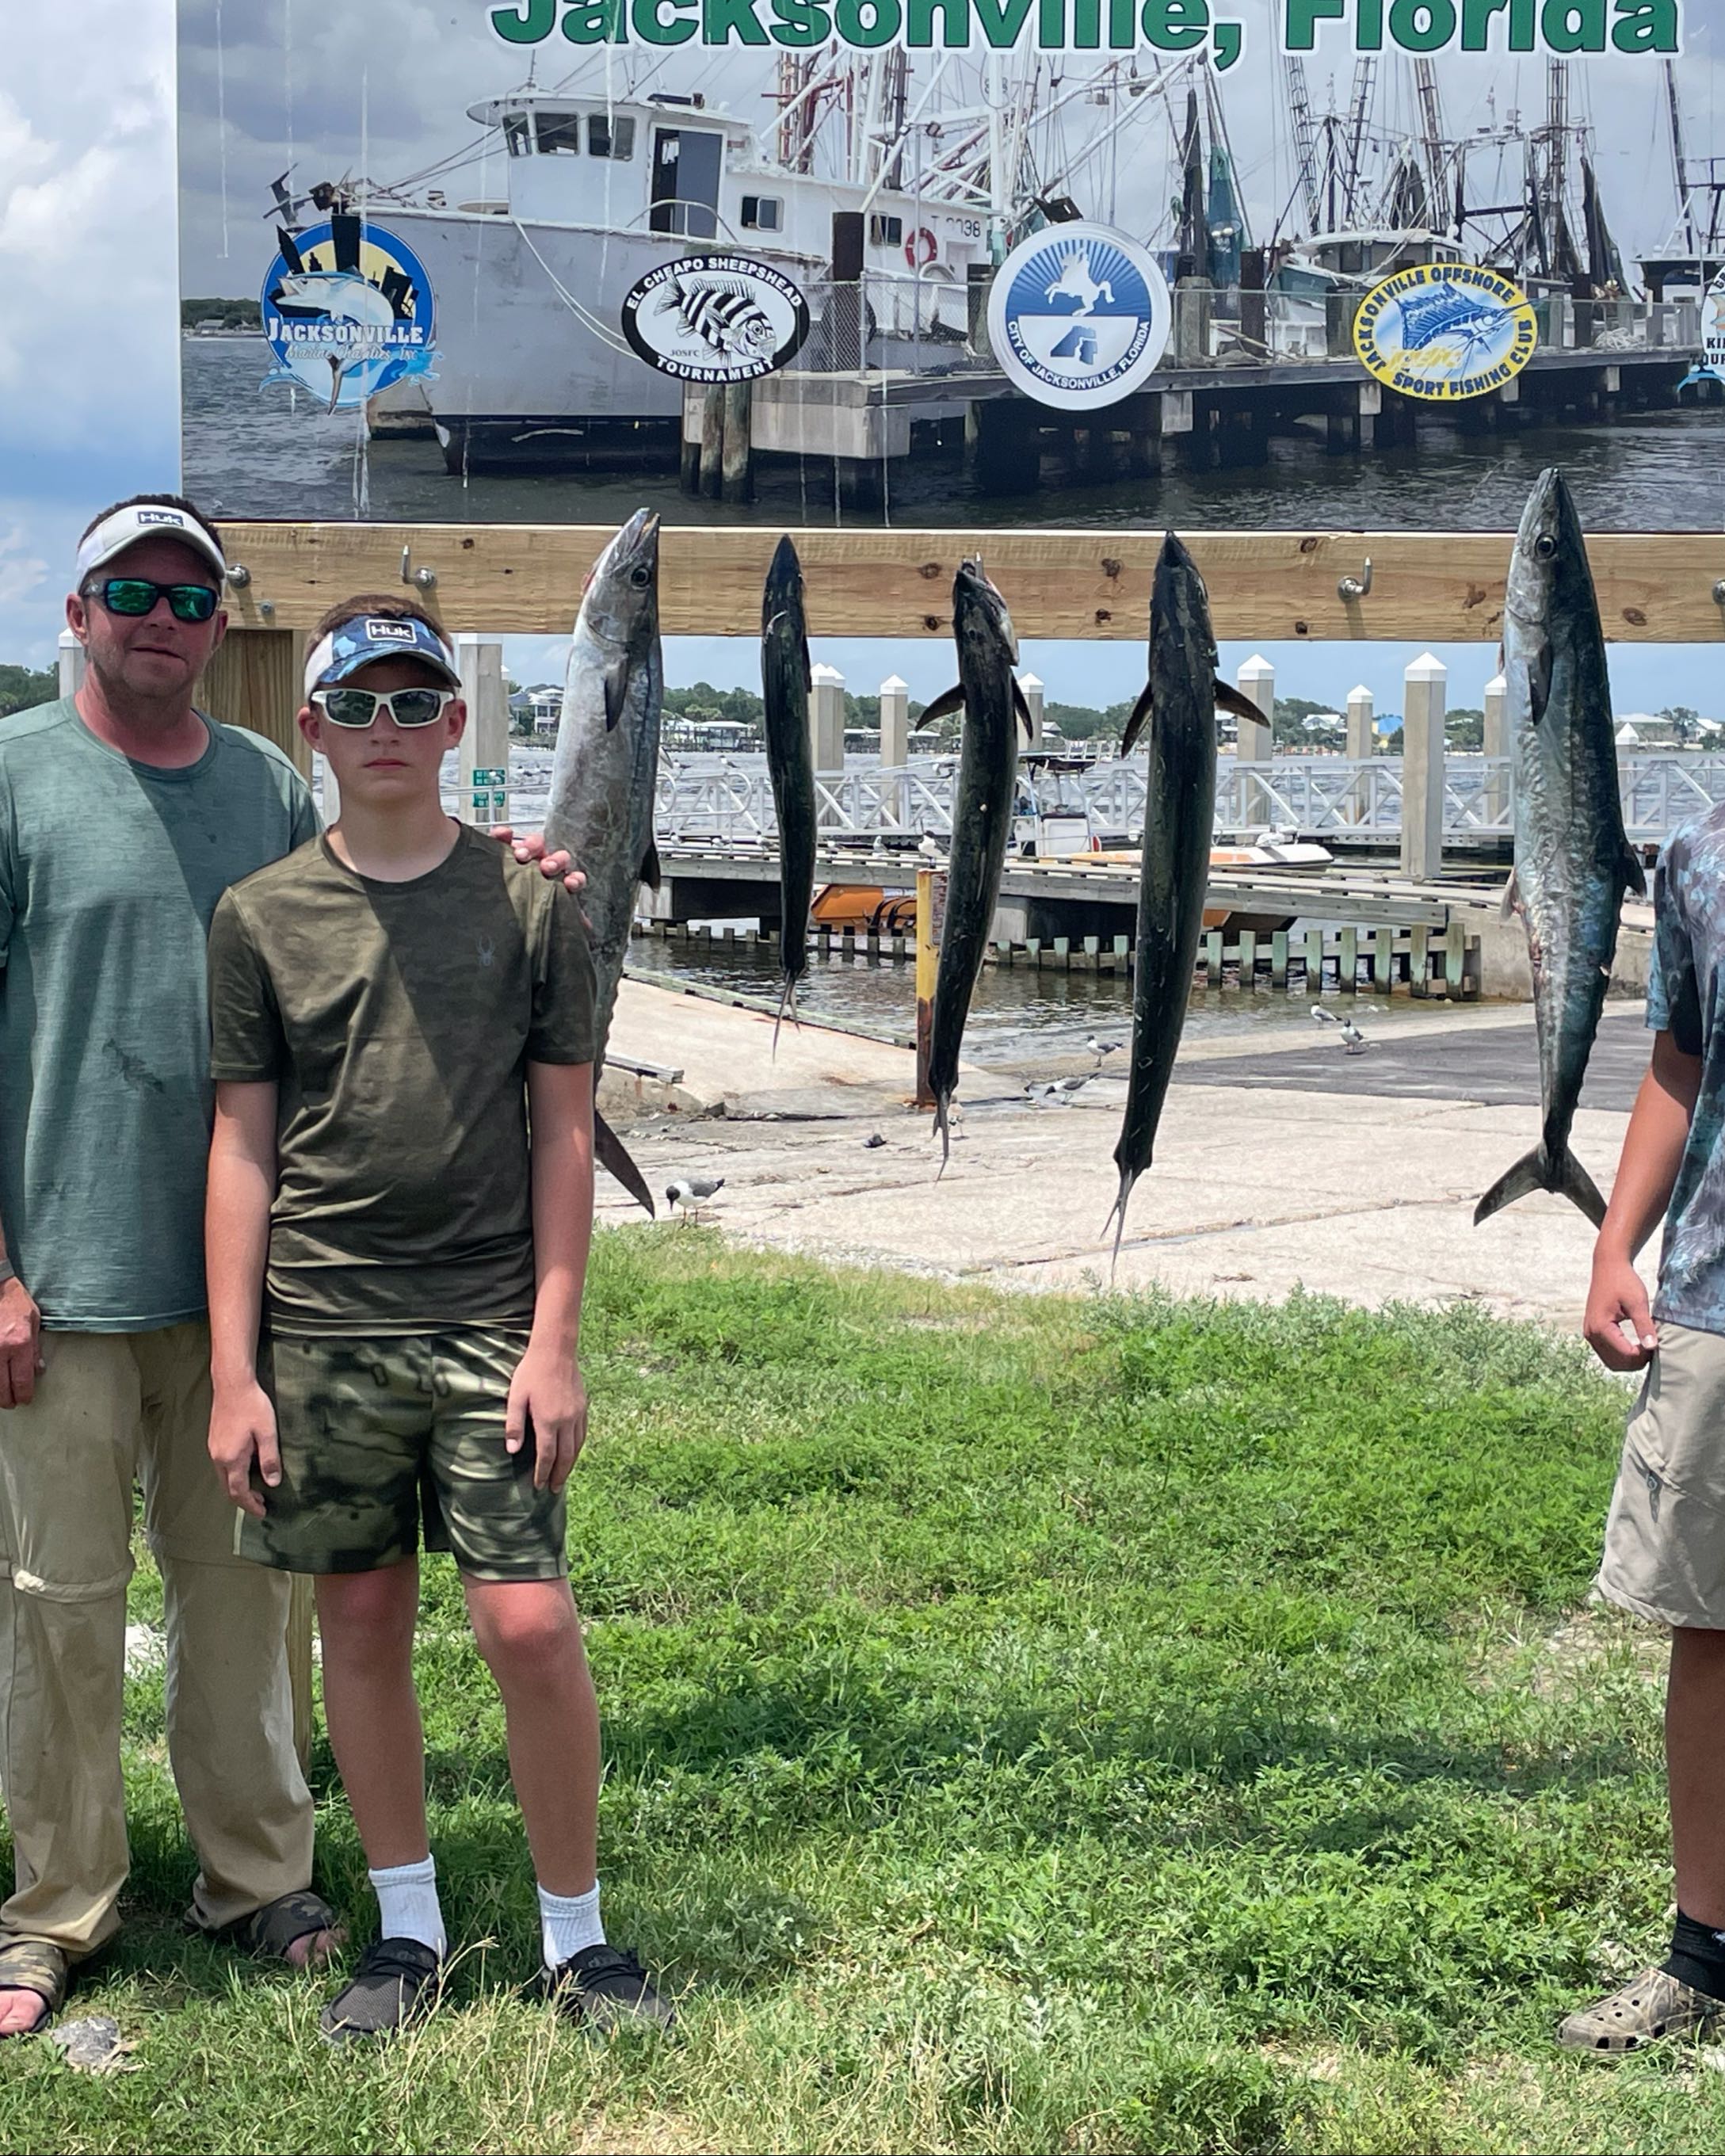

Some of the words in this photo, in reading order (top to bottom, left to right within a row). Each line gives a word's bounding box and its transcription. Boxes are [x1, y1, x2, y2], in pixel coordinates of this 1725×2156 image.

[490, 0, 1242, 71] Jacksonville,
[1284, 0, 1678, 53] Florida
[627, 291, 643, 310] EL
[644, 258, 704, 289] CHEAPO
[708, 258, 802, 307] SHEEPSHEAD
[284, 344, 333, 360] Marine
[1359, 270, 1425, 371] JACKSONVILLE
[1430, 267, 1516, 303] OFFSHORE
[657, 356, 774, 382] TOURNAMENT
[1008, 321, 1023, 349] CITY
[1019, 351, 1036, 368] OF
[1032, 362, 1122, 389] JACKSONVILLE,
[1121, 321, 1150, 371] FLORIDA
[1393, 372, 1444, 396] SPORT
[1450, 362, 1512, 396] FISHING
[1509, 319, 1533, 364] CLUB
